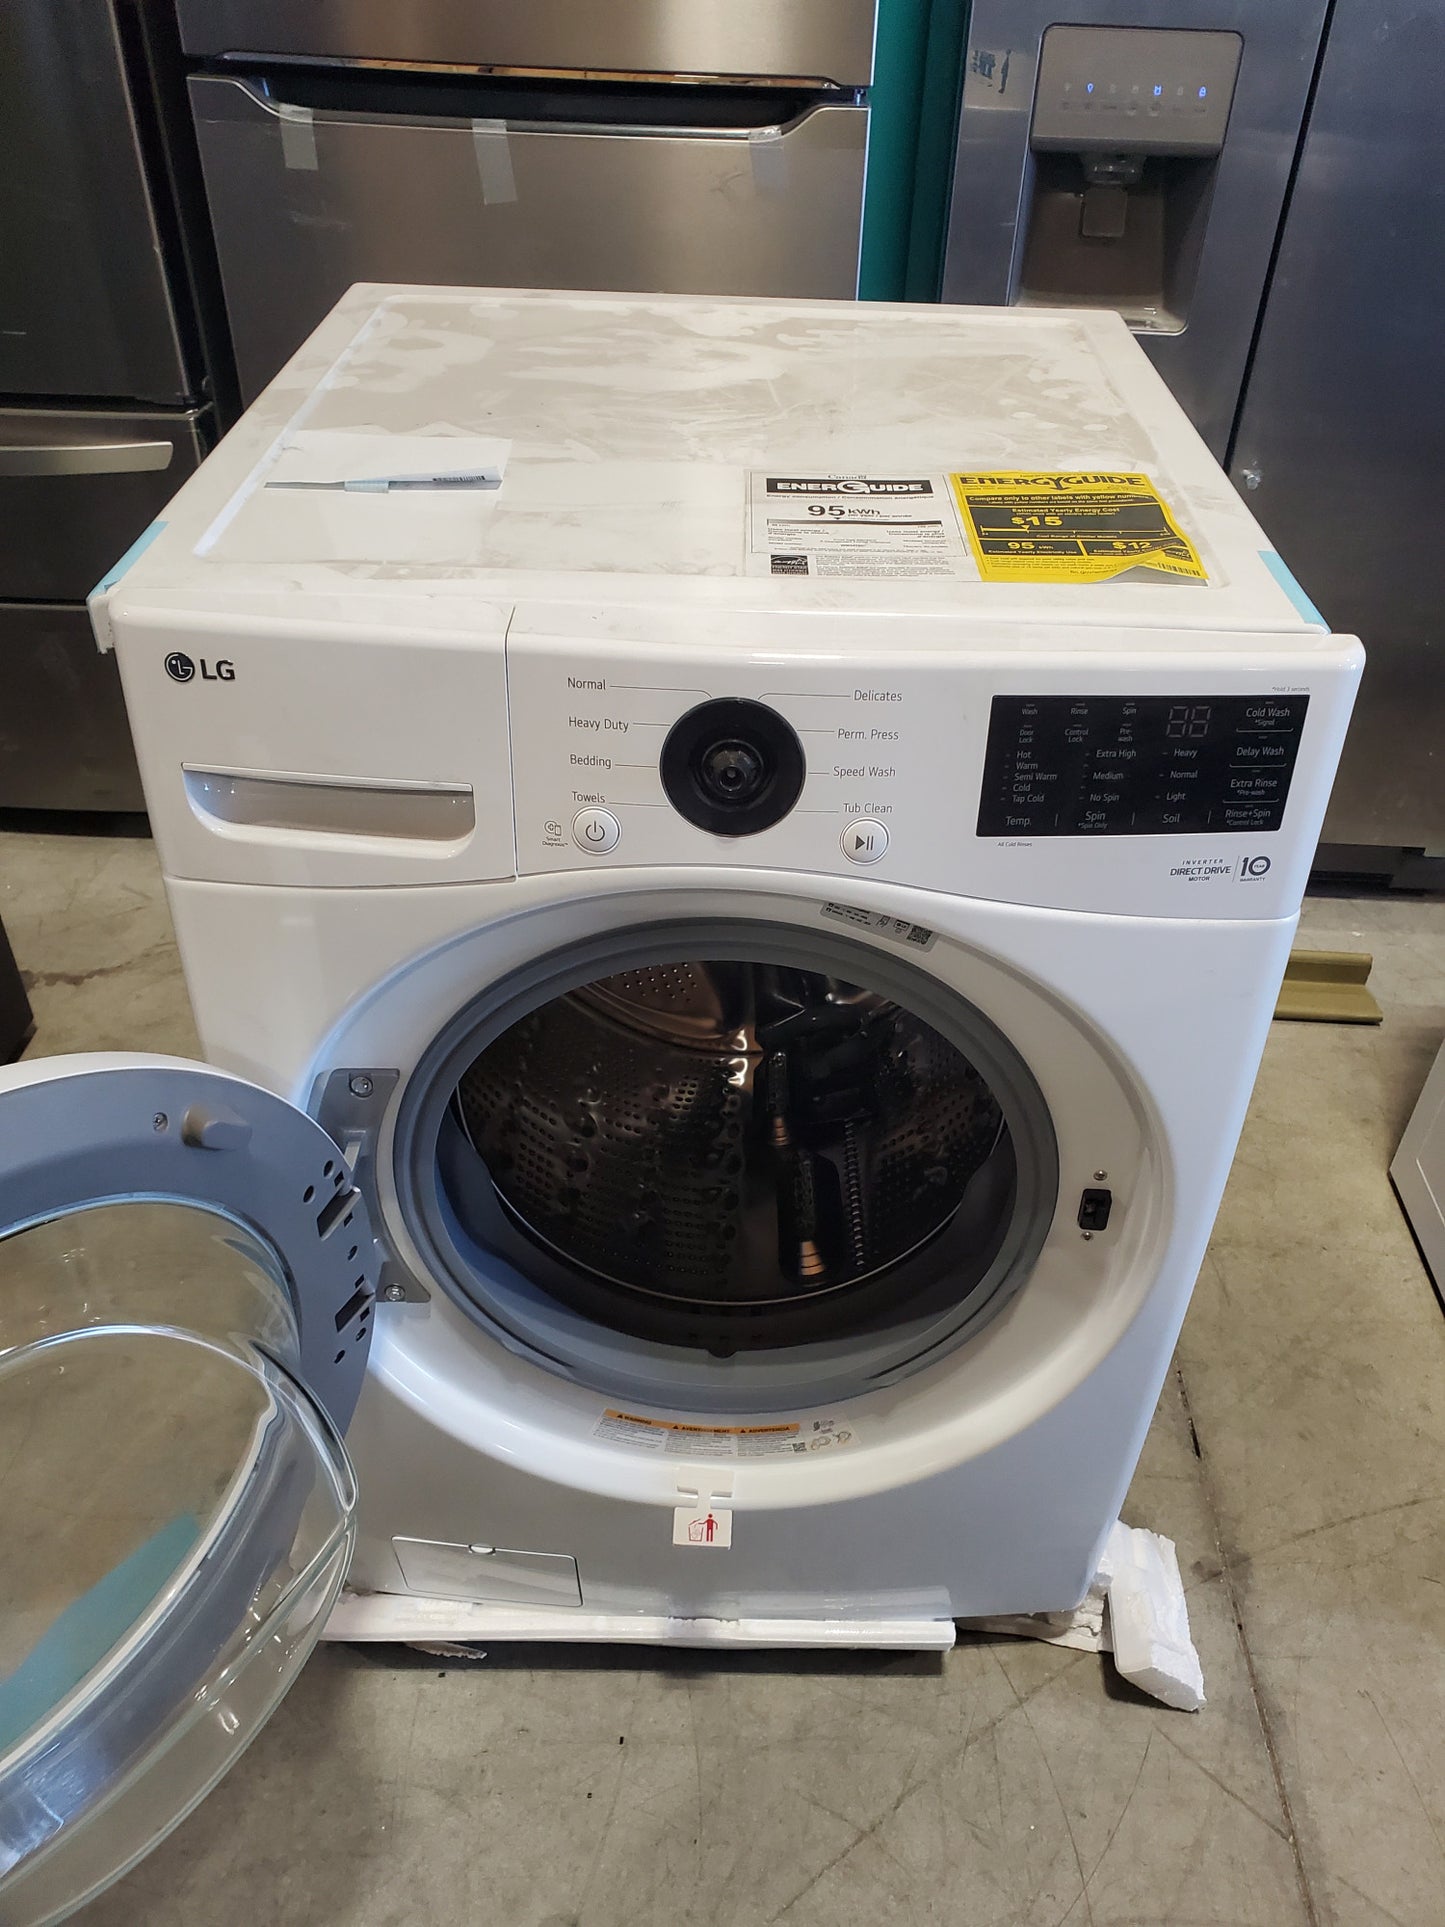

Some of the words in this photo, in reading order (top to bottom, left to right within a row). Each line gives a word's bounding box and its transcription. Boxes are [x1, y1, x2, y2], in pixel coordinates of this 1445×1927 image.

[777, 480, 923, 494] ENERGUIDE
[960, 476, 1145, 490] ENERGYGUIDE
[808, 505, 846, 516] 95
[1012, 516, 1063, 526] $15
[1008, 542, 1035, 550] 95
[1112, 541, 1152, 550] $12
[200, 658, 236, 681] LG
[567, 677, 606, 690] Normal
[854, 690, 902, 702] Delicates
[1122, 706, 1136, 716] Spin
[1246, 708, 1266, 718] Cold
[1268, 708, 1290, 717] Wash
[568, 716, 600, 732] Heavy
[604, 718, 629, 734] Duty
[838, 728, 867, 740] Perm.
[870, 728, 899, 740] Press
[1096, 749, 1116, 758] Extra
[1118, 749, 1137, 760] High
[1174, 748, 1198, 759] Heavy
[1236, 747, 1260, 758] Delay
[1262, 747, 1284, 756] Wash
[570, 754, 612, 770] Bedding
[1016, 762, 1038, 770] Warm
[833, 766, 865, 779] Speed
[868, 766, 896, 778] Wash
[1014, 772, 1034, 780] Semi
[1035, 772, 1058, 780] Warm
[1092, 772, 1124, 780] Medium
[1170, 770, 1198, 779] Normal
[1012, 784, 1031, 792] Cold
[1230, 778, 1252, 788] Extra
[1254, 778, 1278, 788] Rinse
[572, 791, 606, 804] Towels
[1012, 794, 1026, 804] Tap
[1026, 794, 1045, 802] Cold
[1090, 794, 1101, 802] No
[1103, 793, 1120, 803] Spin
[1166, 792, 1186, 802] Light
[843, 803, 860, 814] Tub
[864, 802, 893, 814] Clean
[1085, 810, 1106, 822] Spin
[1162, 814, 1180, 824] Soil
[1225, 808, 1271, 820] Rinse+Spin
[1006, 816, 1032, 828] Temp.
[1182, 858, 1224, 866] INVERTER
[1240, 856, 1272, 876] 10
[1170, 866, 1203, 876] DIRECT
[1204, 866, 1232, 875] DRIVE
